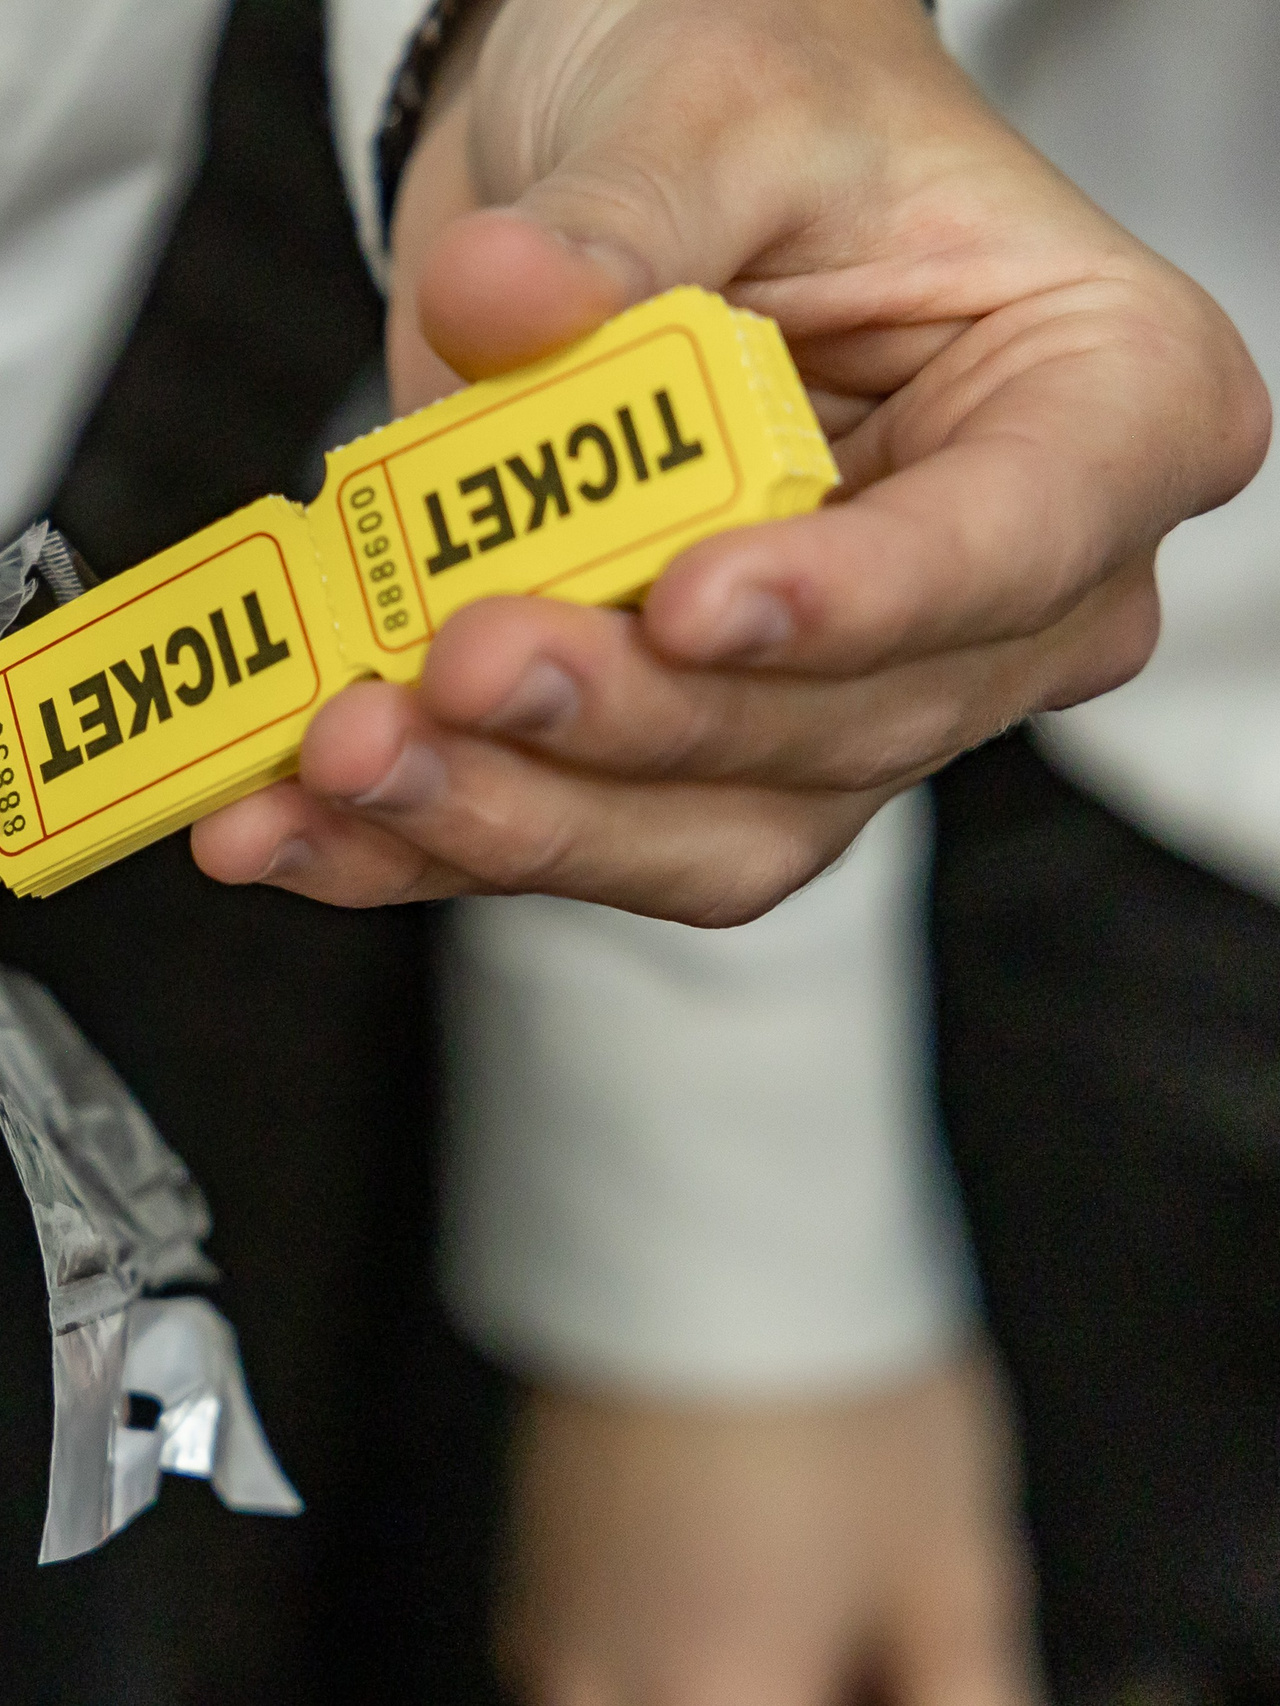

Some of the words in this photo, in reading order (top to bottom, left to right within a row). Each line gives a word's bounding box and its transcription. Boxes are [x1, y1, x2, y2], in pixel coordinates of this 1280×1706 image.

[348, 486, 409, 633] 888600
[424, 389, 705, 576] TICKET
[38, 590, 291, 785] TICKET
